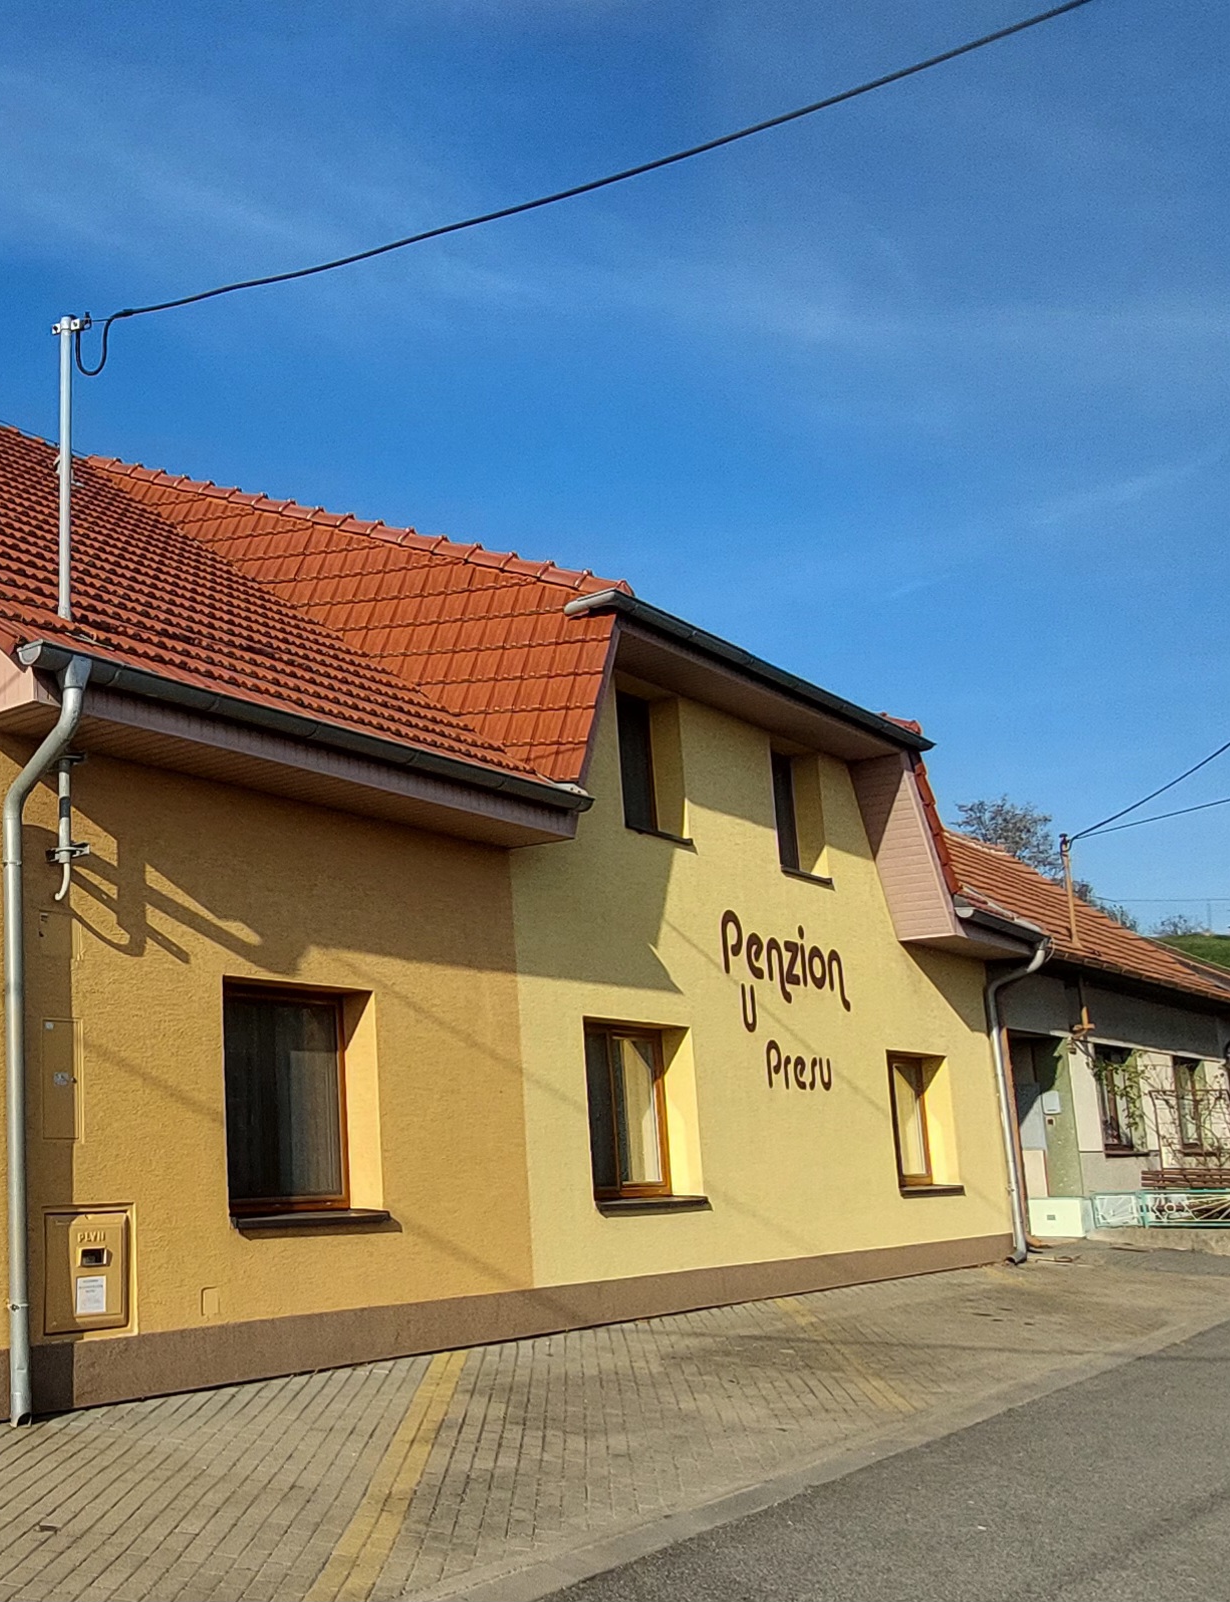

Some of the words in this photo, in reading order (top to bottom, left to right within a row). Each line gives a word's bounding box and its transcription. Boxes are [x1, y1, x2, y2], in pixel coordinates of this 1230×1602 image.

[720, 909, 851, 1013] Penzion
[740, 983, 758, 1034] U
[765, 1039, 832, 1092] Presu
